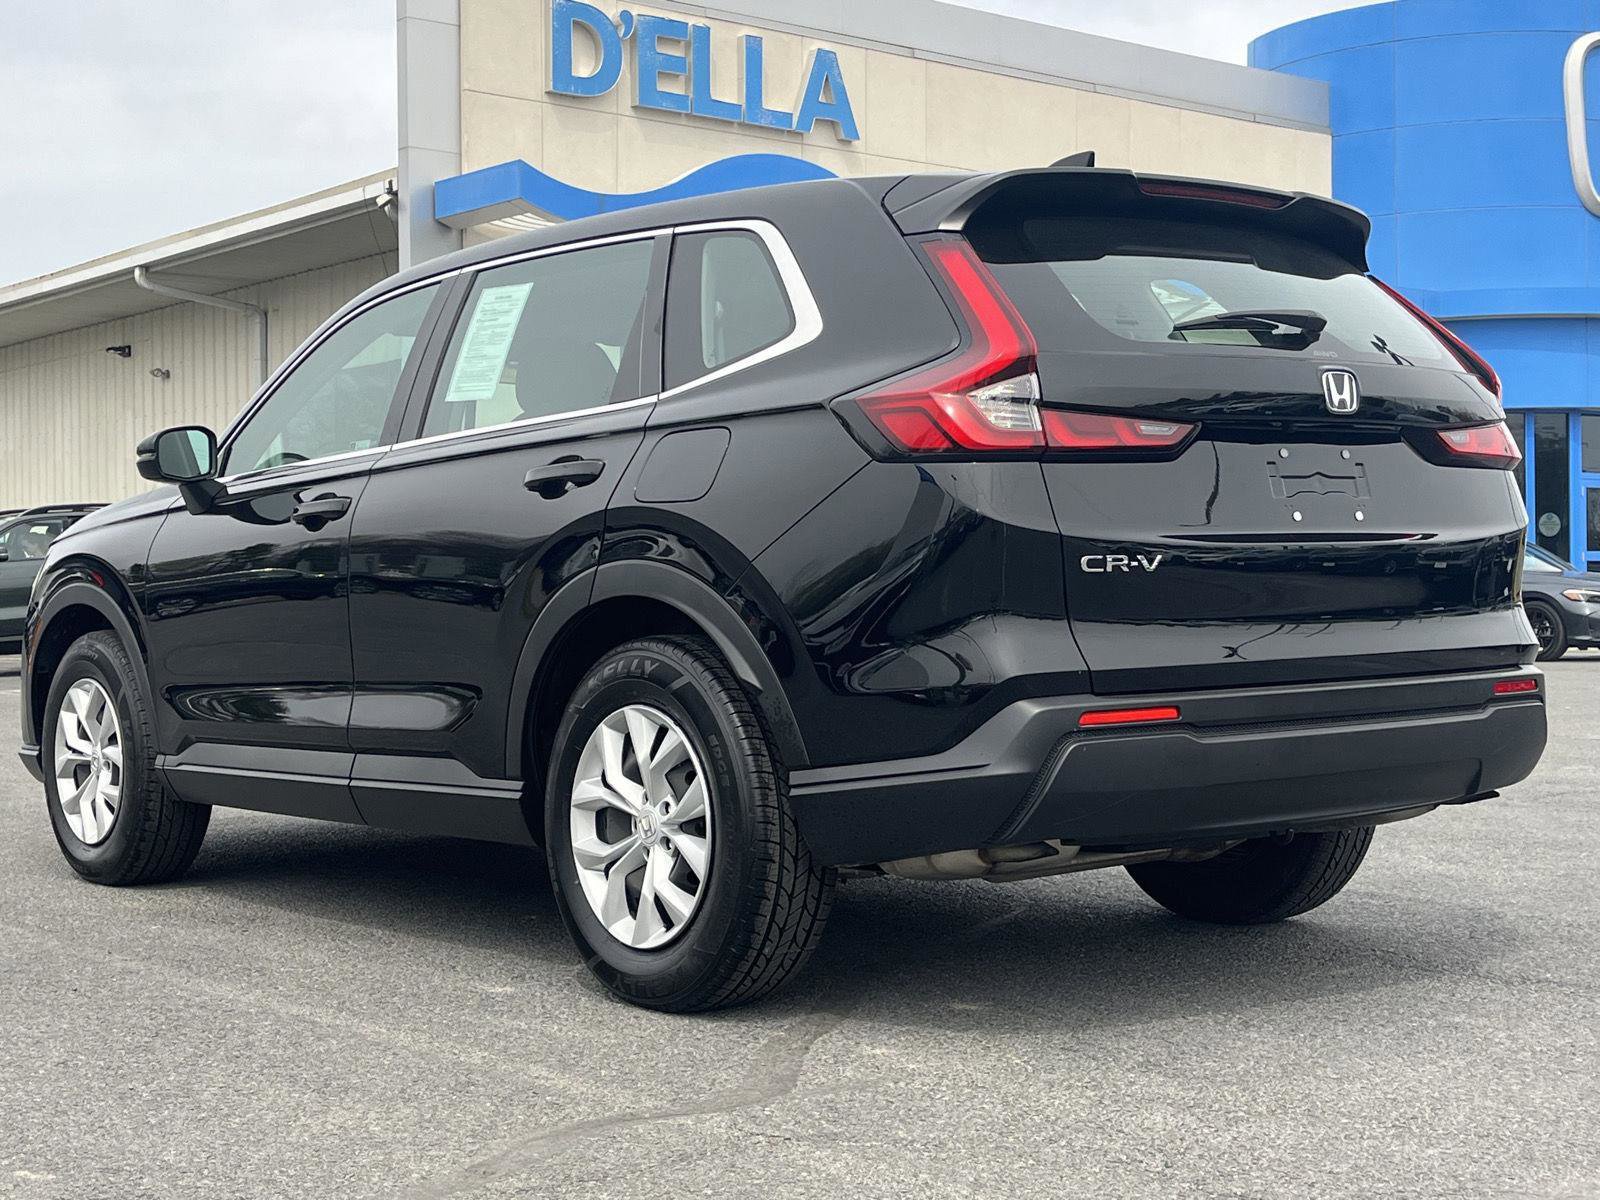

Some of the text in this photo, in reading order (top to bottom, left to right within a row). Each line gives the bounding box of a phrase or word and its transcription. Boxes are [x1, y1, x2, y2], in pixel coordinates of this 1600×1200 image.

[546, 0, 860, 141] D'ELLA
[1080, 554, 1162, 572] CR-V
[588, 657, 660, 688] KELLY
